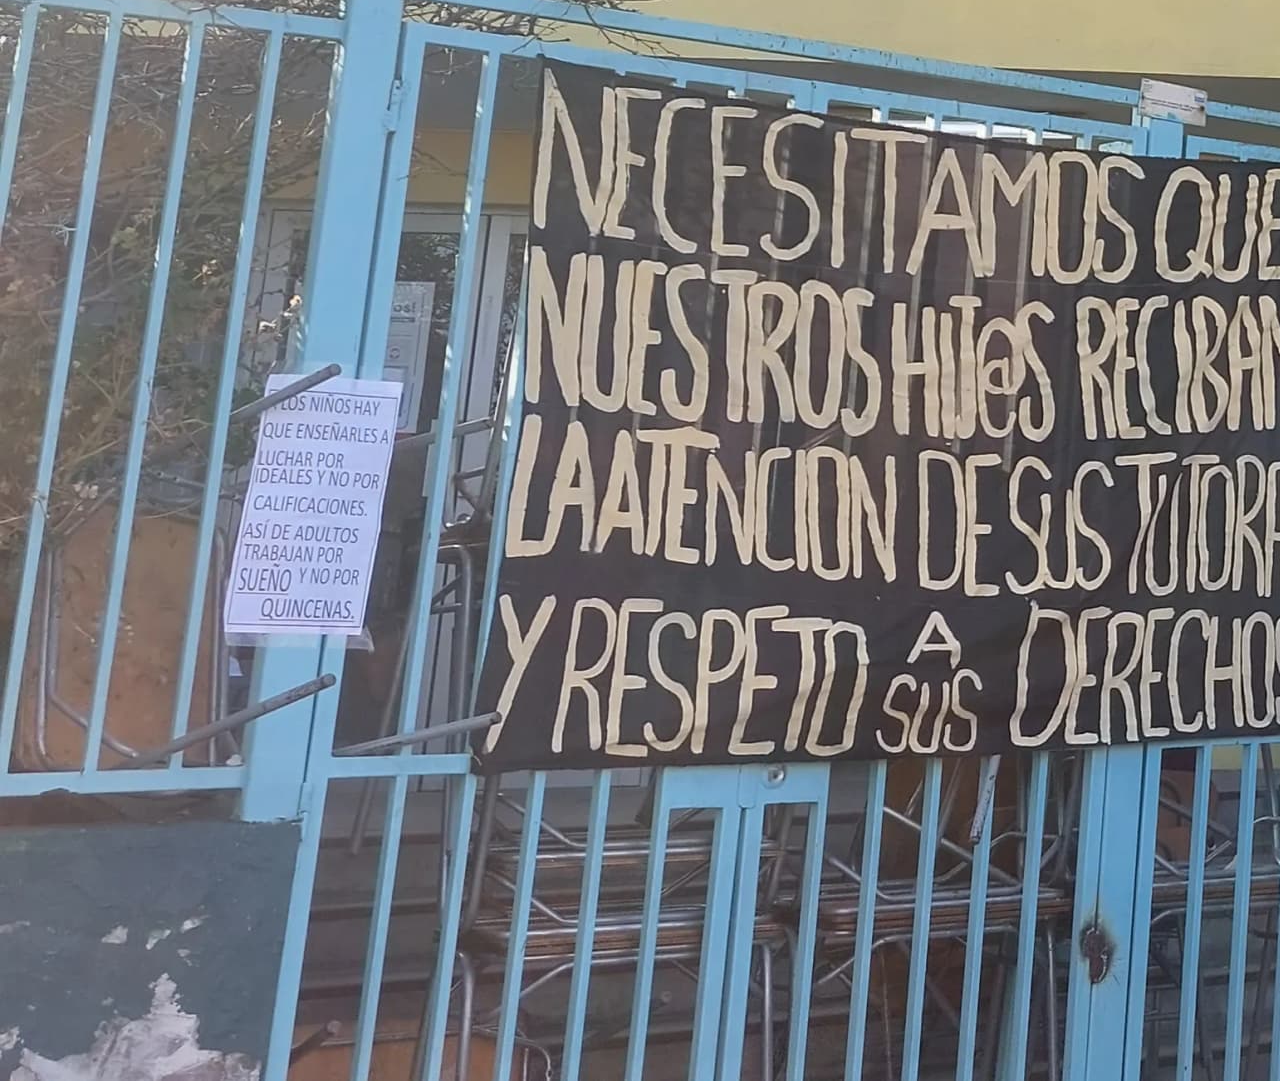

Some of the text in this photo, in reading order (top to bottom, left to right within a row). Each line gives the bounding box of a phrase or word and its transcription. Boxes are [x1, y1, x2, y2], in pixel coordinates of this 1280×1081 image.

[532, 68, 1148, 285] NECESITAMOS
[524, 250, 883, 439] NUESTROS
[890, 293, 1056, 442] HIJ@S
[281, 395, 306, 411] LOS
[310, 393, 351, 414] NIÑOS
[353, 400, 381, 416] HAY
[263, 422, 388, 444] QUE ENSEÑARLES A
[257, 450, 344, 469] LUCHAR POR
[255, 468, 380, 489] IDEALES Y NO POR
[253, 495, 367, 516] CALIFICACIONES.
[243, 519, 359, 543] ASÍ DE ADULTOS
[918, 449, 1002, 598] DE
[1005, 455, 1115, 595] SUS
[244, 544, 344, 563] TRABAJAN POR
[238, 563, 360, 593] SUEÑO Y NO POR
[261, 598, 354, 620] QUINCENAS.
[907, 610, 962, 669] A
[483, 593, 557, 755] Y
[551, 596, 869, 760] RESPETO
[875, 672, 984, 757] SUS
